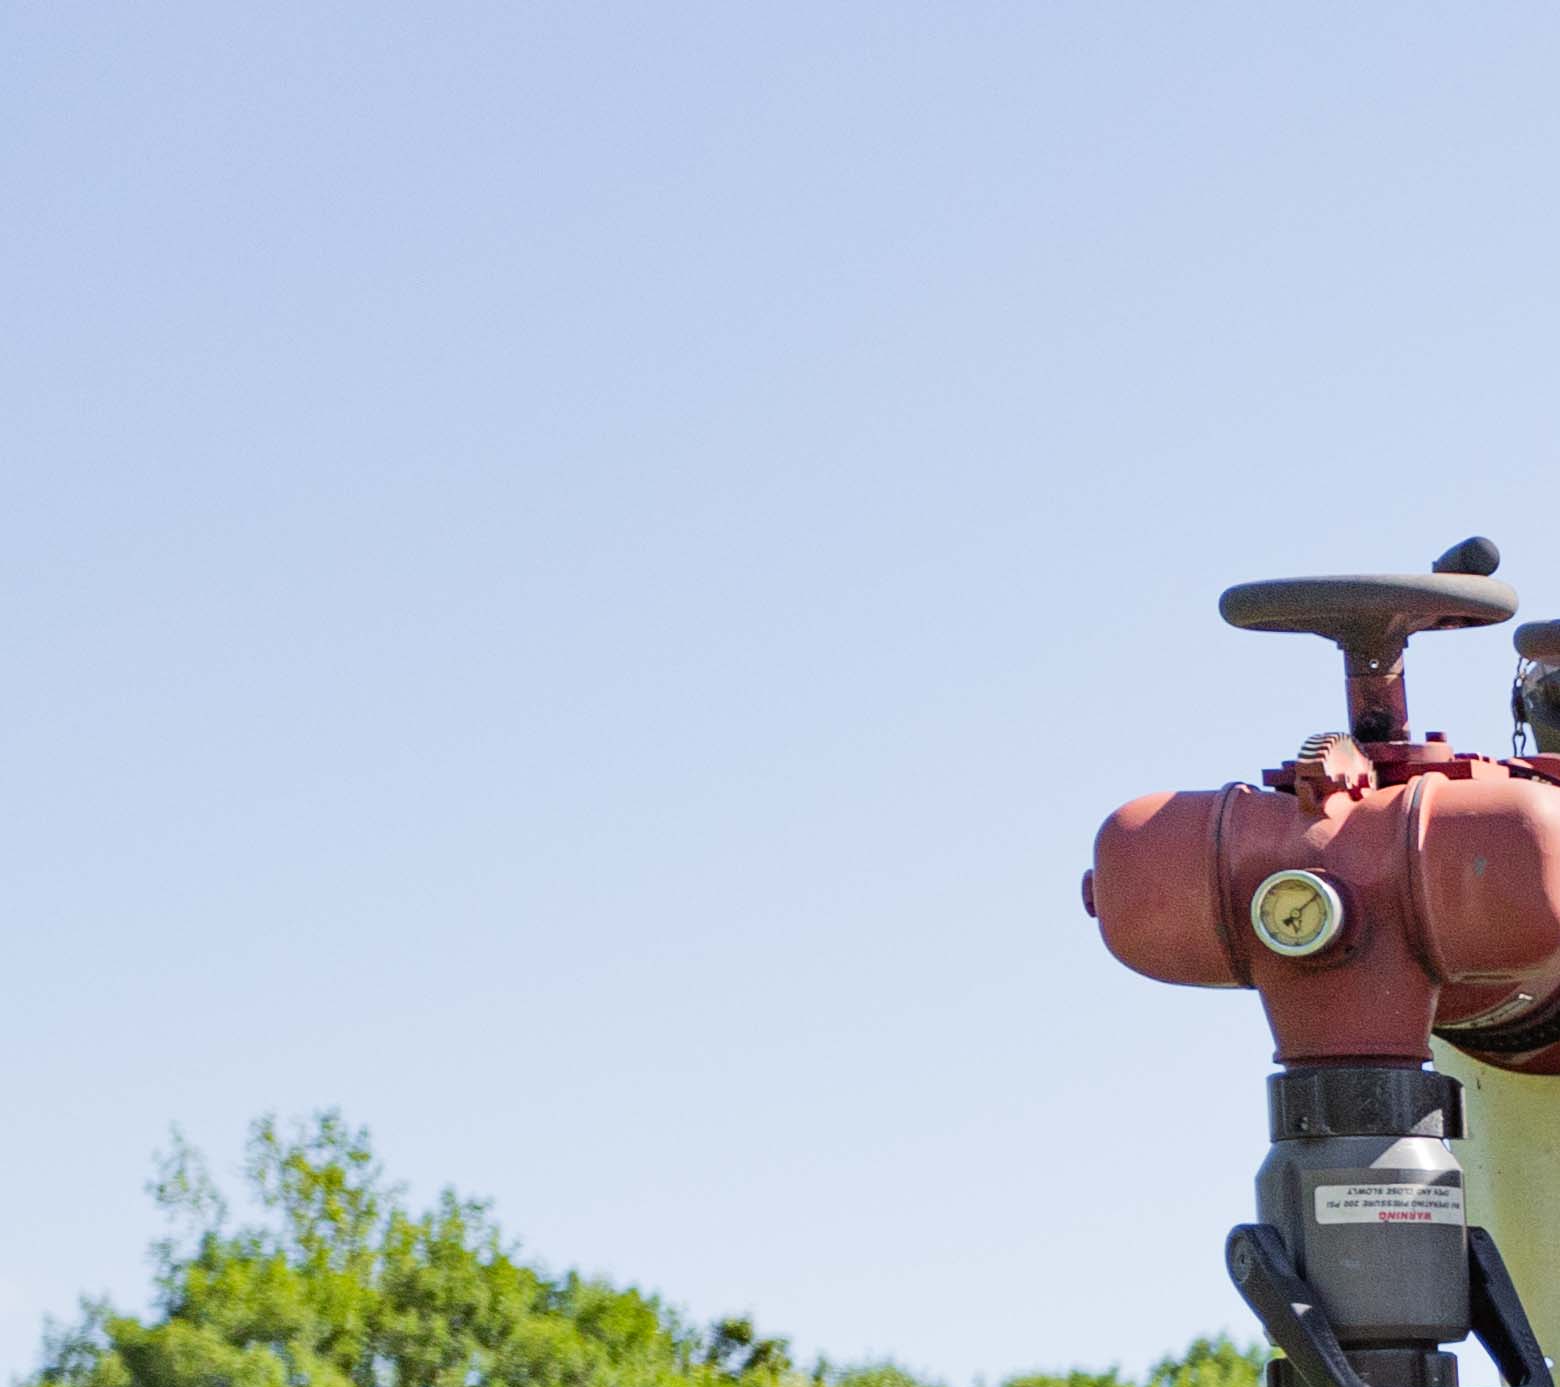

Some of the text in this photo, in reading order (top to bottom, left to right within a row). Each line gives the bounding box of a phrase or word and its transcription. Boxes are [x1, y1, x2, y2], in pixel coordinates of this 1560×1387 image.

[1347, 1187, 1383, 1196] SLOWLY
[1387, 1187, 1413, 1196] CLOSE
[1326, 1201, 1341, 1209] PSI
[1343, 1200, 1359, 1209] 200
[1362, 1200, 1409, 1209] PRESSURE
[1411, 1200, 1449, 1209] OPERATING
[1378, 1211, 1432, 1221] WARNING
